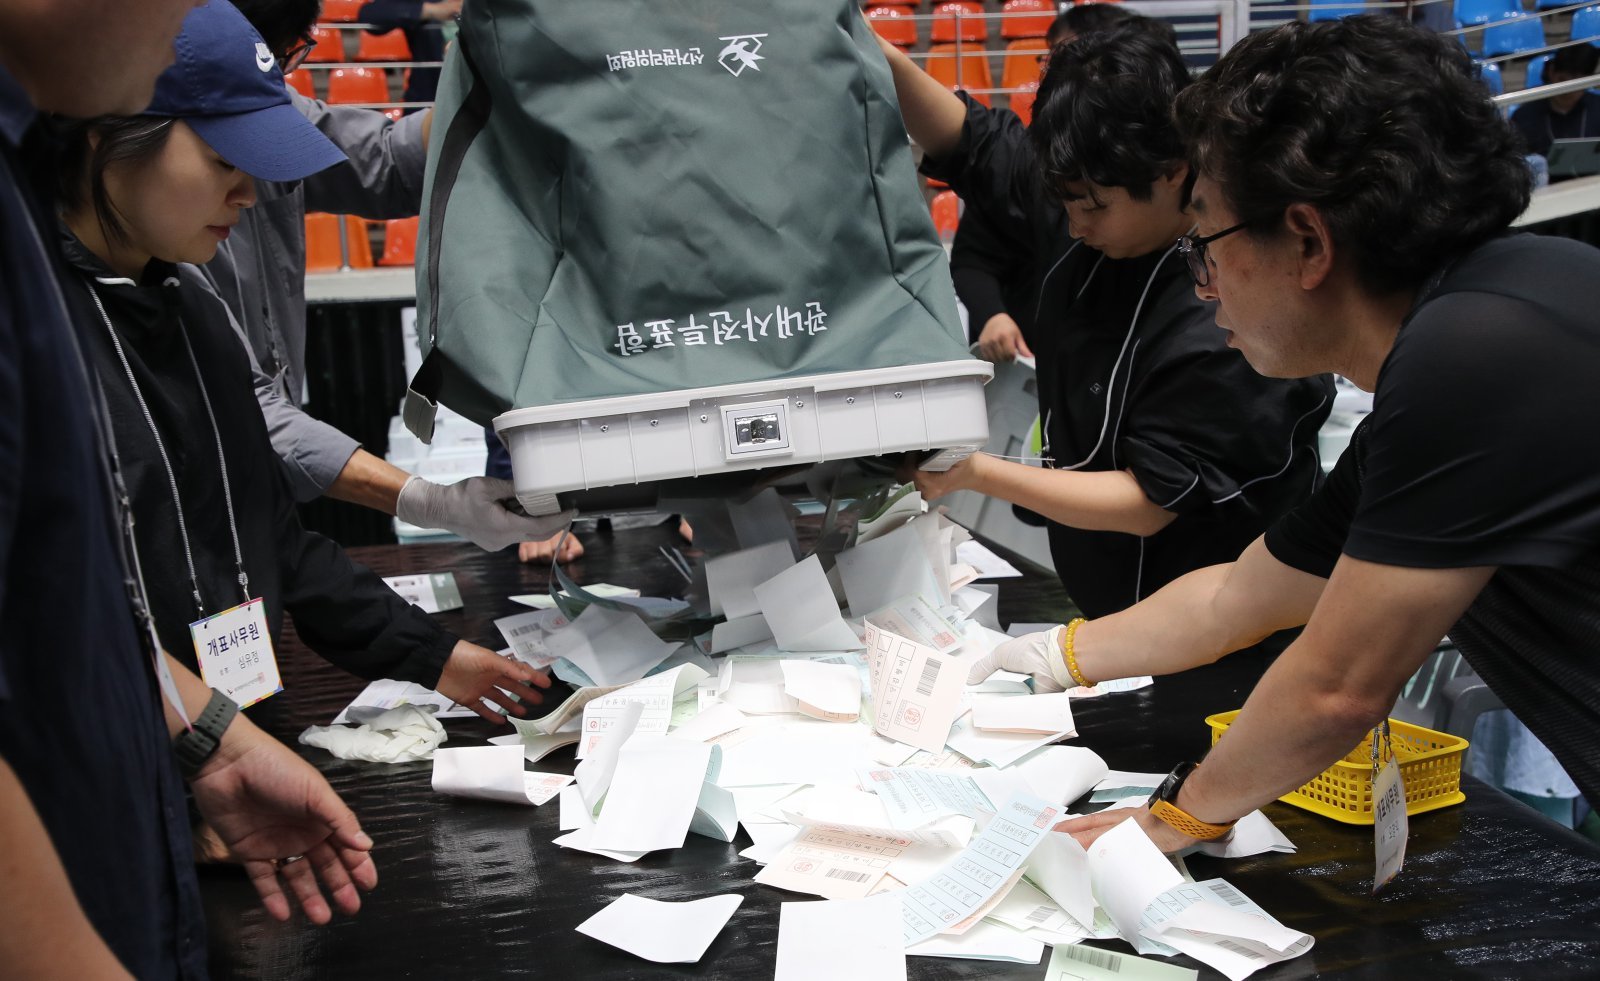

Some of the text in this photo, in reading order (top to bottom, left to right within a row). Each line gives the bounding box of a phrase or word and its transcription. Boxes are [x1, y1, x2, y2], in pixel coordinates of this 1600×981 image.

[606, 47, 705, 72] 선거관리위원회
[614, 301, 828, 356] 관내사전투표함
[207, 621, 260, 657] 개표사무원
[238, 650, 260, 669] 심유정
